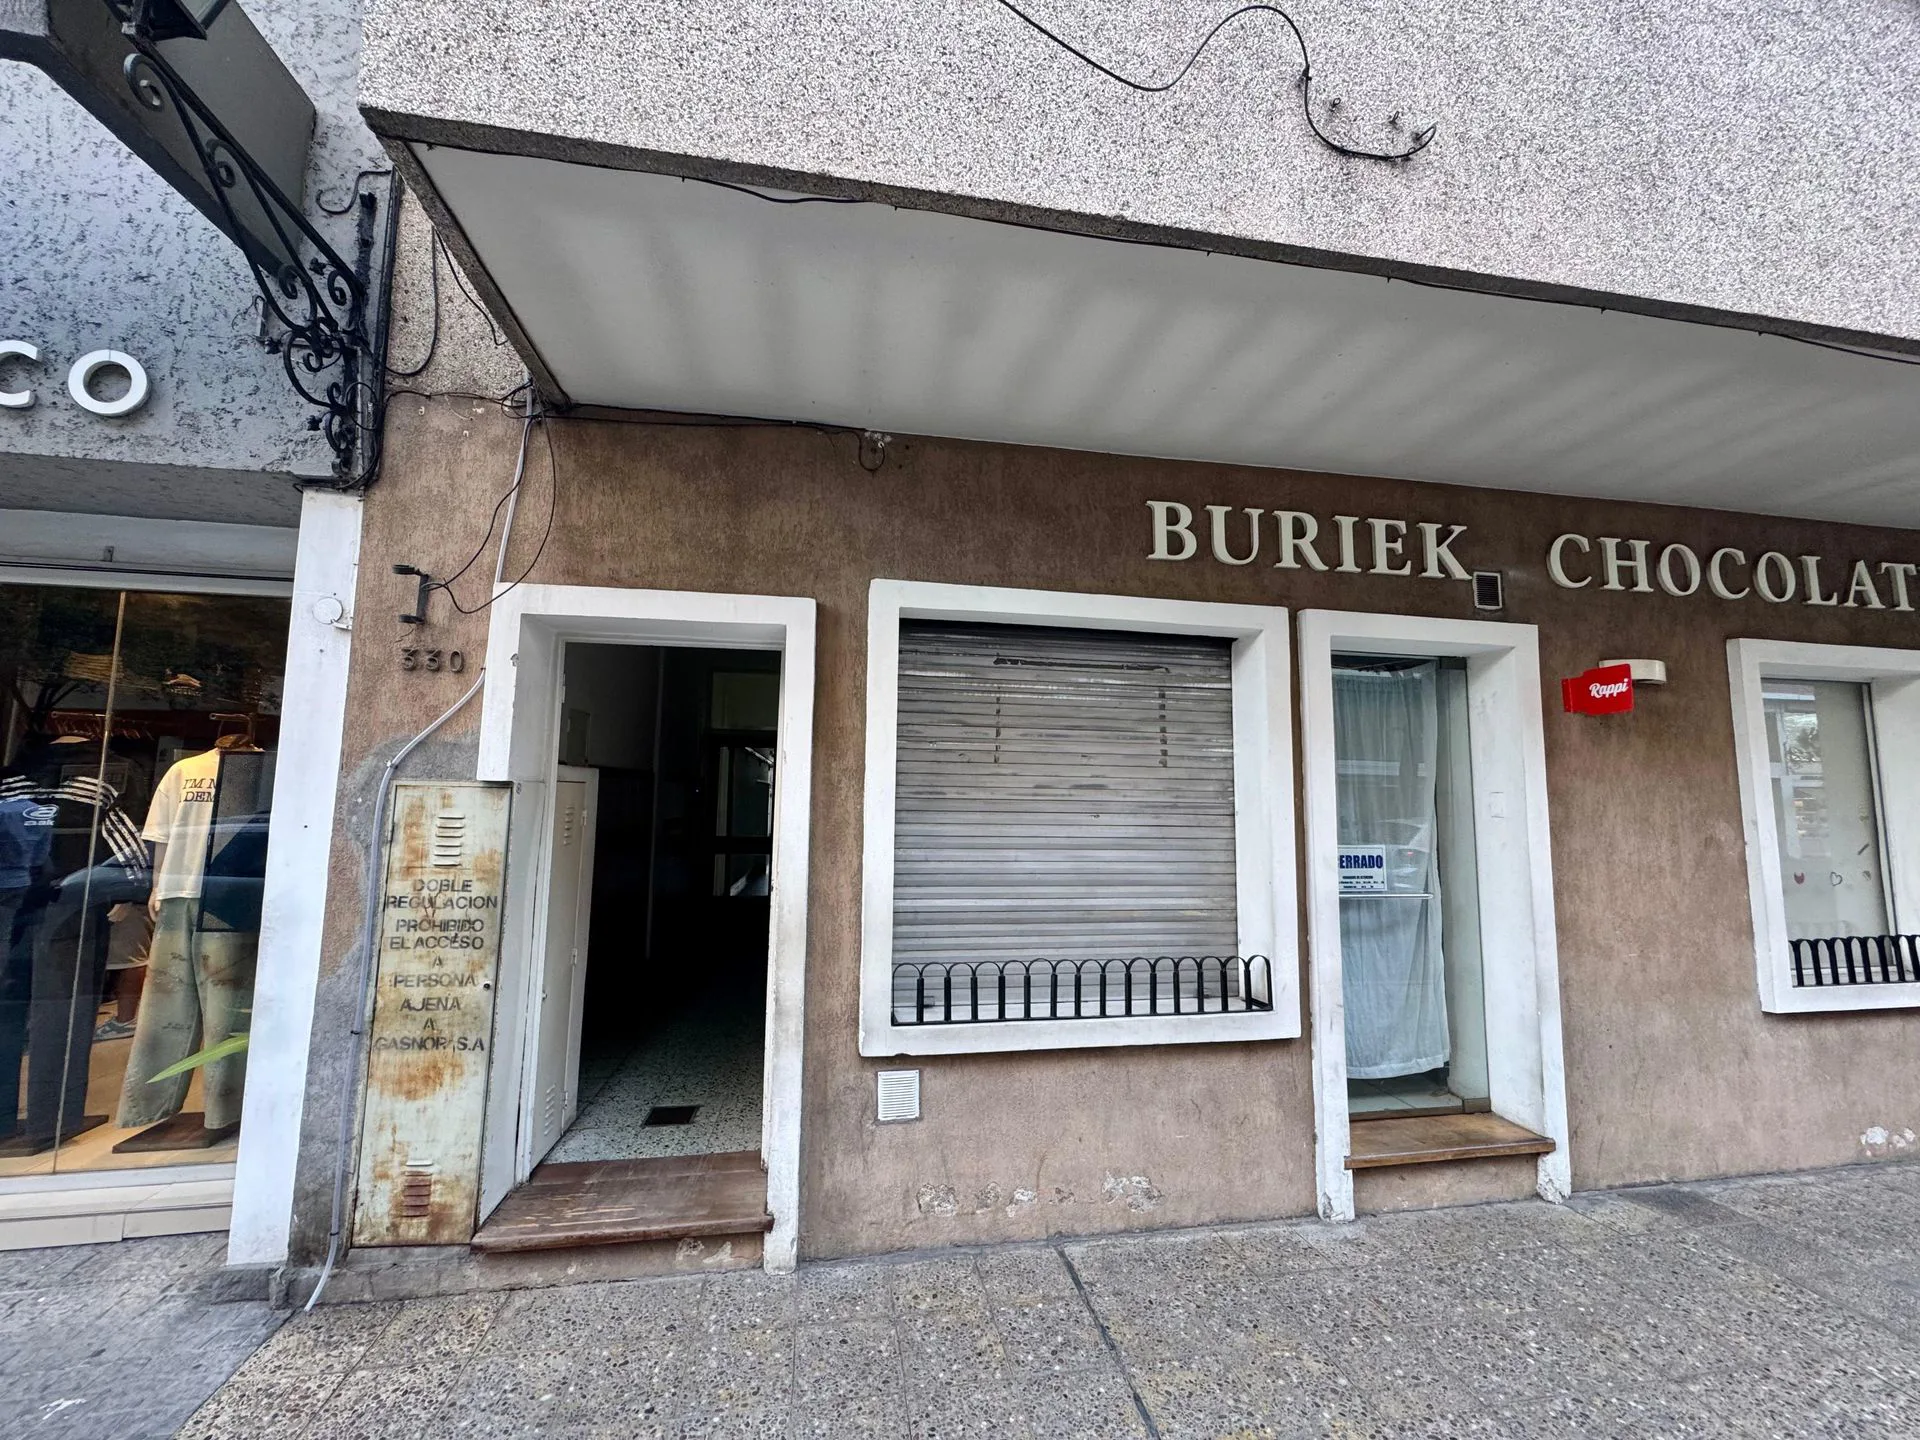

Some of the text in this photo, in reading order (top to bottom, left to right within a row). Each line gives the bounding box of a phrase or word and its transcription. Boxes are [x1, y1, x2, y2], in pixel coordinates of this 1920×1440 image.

[1145, 500, 1920, 611] BURIEK CHOCOLAT
[401, 648, 464, 673] 330
[1588, 678, 1629, 698] Rappi
[1339, 854, 1384, 869] ERRADO
[412, 879, 473, 893] DOBLE
[386, 895, 498, 909] REGULACION
[395, 918, 485, 933] PROHIBIDO
[389, 935, 485, 950] EL ACCESO
[432, 955, 443, 968] A
[393, 973, 477, 988] PERSONA
[400, 996, 461, 1012] AJENA
[423, 1017, 435, 1031] A
